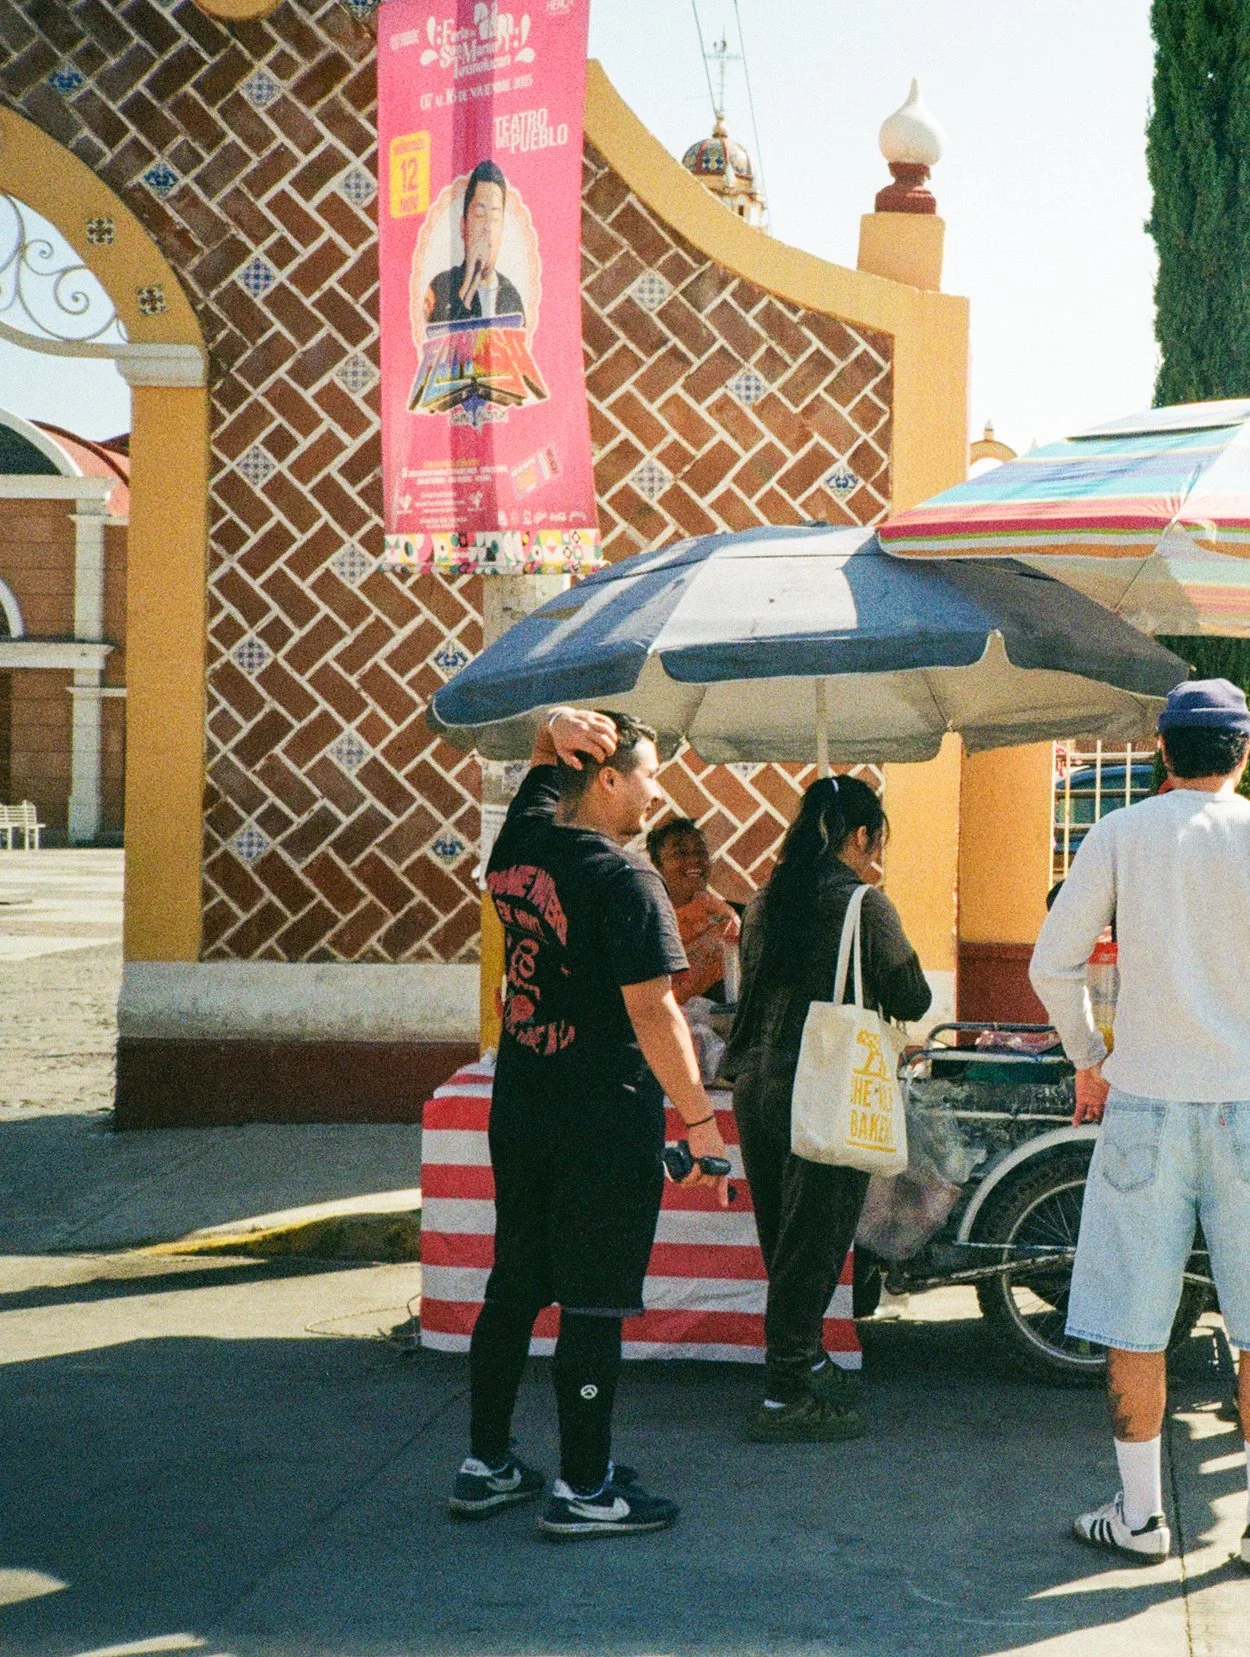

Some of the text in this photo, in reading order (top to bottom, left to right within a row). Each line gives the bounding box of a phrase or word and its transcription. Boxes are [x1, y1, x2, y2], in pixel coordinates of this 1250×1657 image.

[493, 107, 548, 138] TEATRO
[510, 123, 569, 155] PUEBLO
[399, 157, 419, 193] 12
